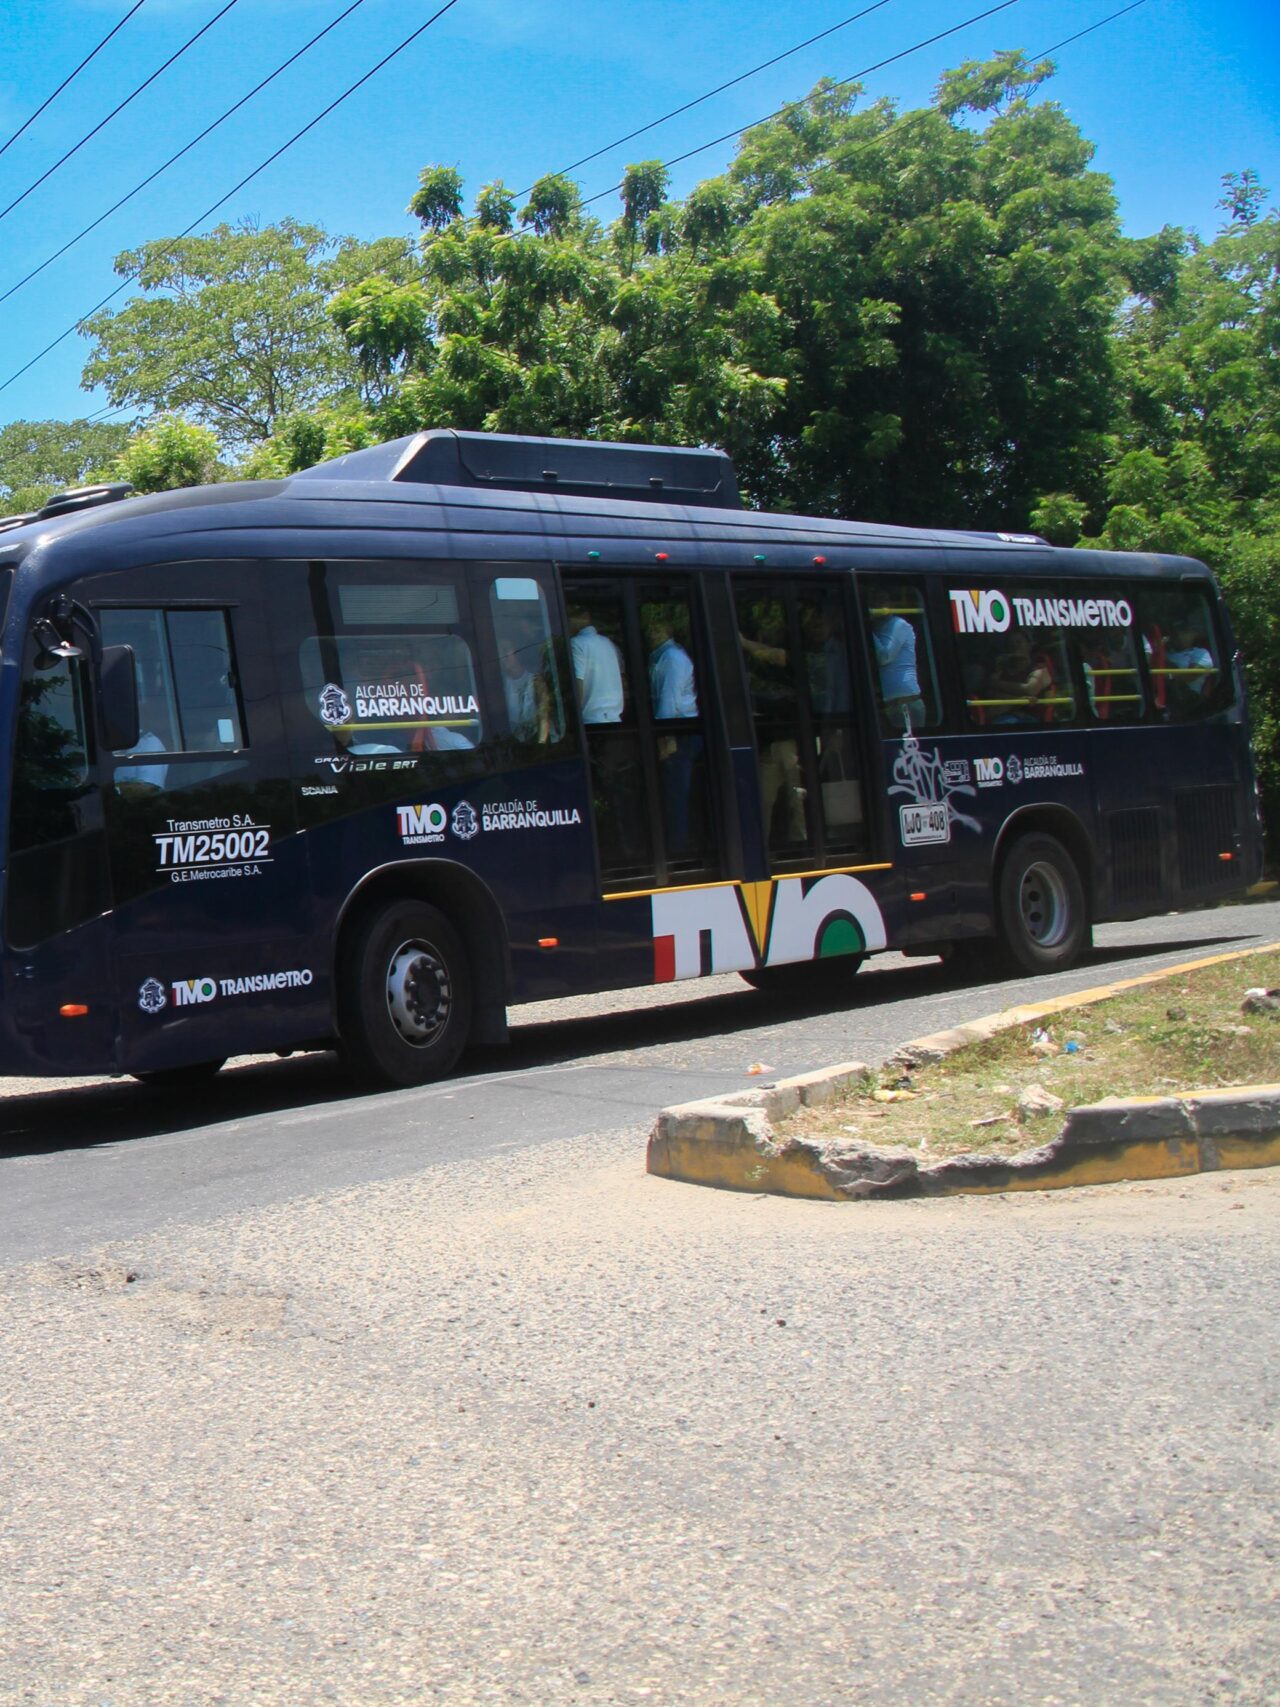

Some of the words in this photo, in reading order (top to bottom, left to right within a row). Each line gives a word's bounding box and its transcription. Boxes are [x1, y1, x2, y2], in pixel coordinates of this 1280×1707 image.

[949, 588, 1010, 633] TMO
[355, 681, 405, 699] ALCALDÍA
[407, 683, 425, 697] DE
[355, 694, 479, 718] BARRANQUILLA
[330, 760, 387, 773] Viale
[392, 760, 418, 770] BRT
[973, 757, 1004, 782] TMO
[1049, 755, 1057, 765] DE
[1023, 763, 1084, 779] BARRANQUILLA
[301, 785, 339, 796] SCANIA
[482, 798, 523, 815] ALCALDÍA
[525, 800, 538, 812] DE
[166, 817, 230, 831] Transmetro
[232, 815, 255, 828] S.A.
[396, 803, 447, 836] TMO
[482, 809, 582, 832] BARRANQUILLA
[928, 810, 945, 834] 408
[155, 831, 270, 865] TM25002
[243, 864, 262, 877] S.A.
[171, 977, 217, 1006] TMO
